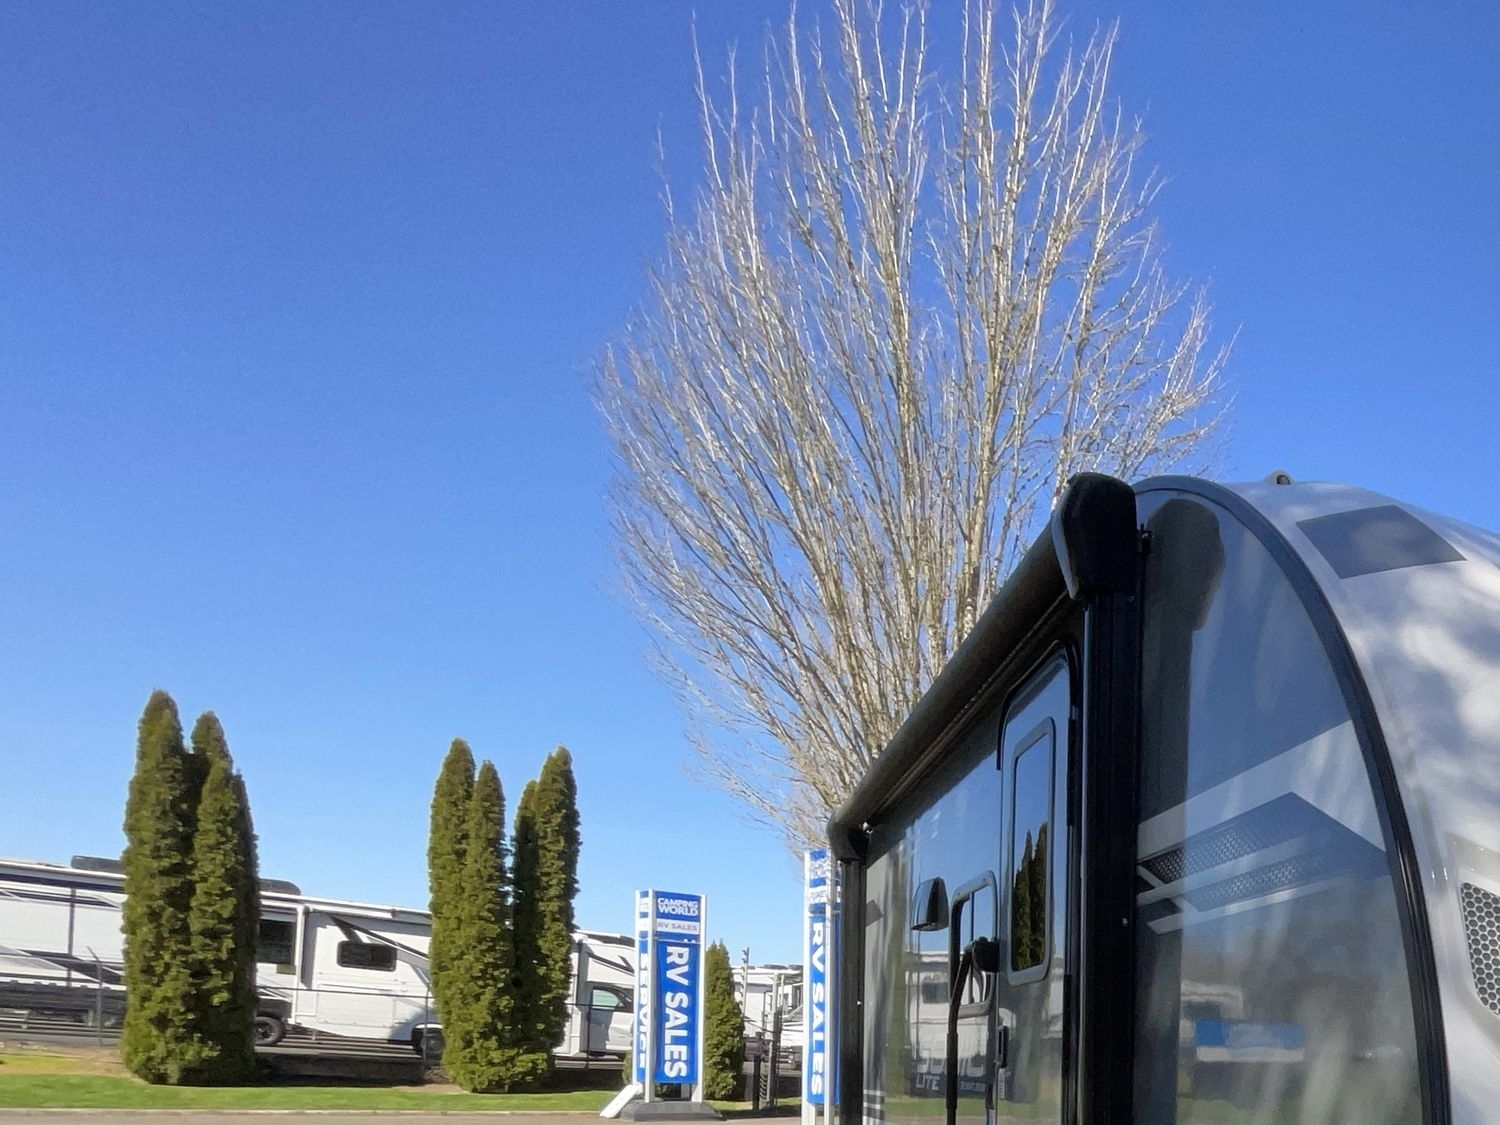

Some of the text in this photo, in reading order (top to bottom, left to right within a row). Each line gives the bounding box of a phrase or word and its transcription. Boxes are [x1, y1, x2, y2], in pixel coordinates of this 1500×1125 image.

[657, 897, 698, 908] CAMPING
[658, 904, 698, 916] WORLD
[657, 921, 698, 932] RV SALES
[664, 946, 689, 1078] RV SALES
[811, 922, 824, 1096] RV SALES
